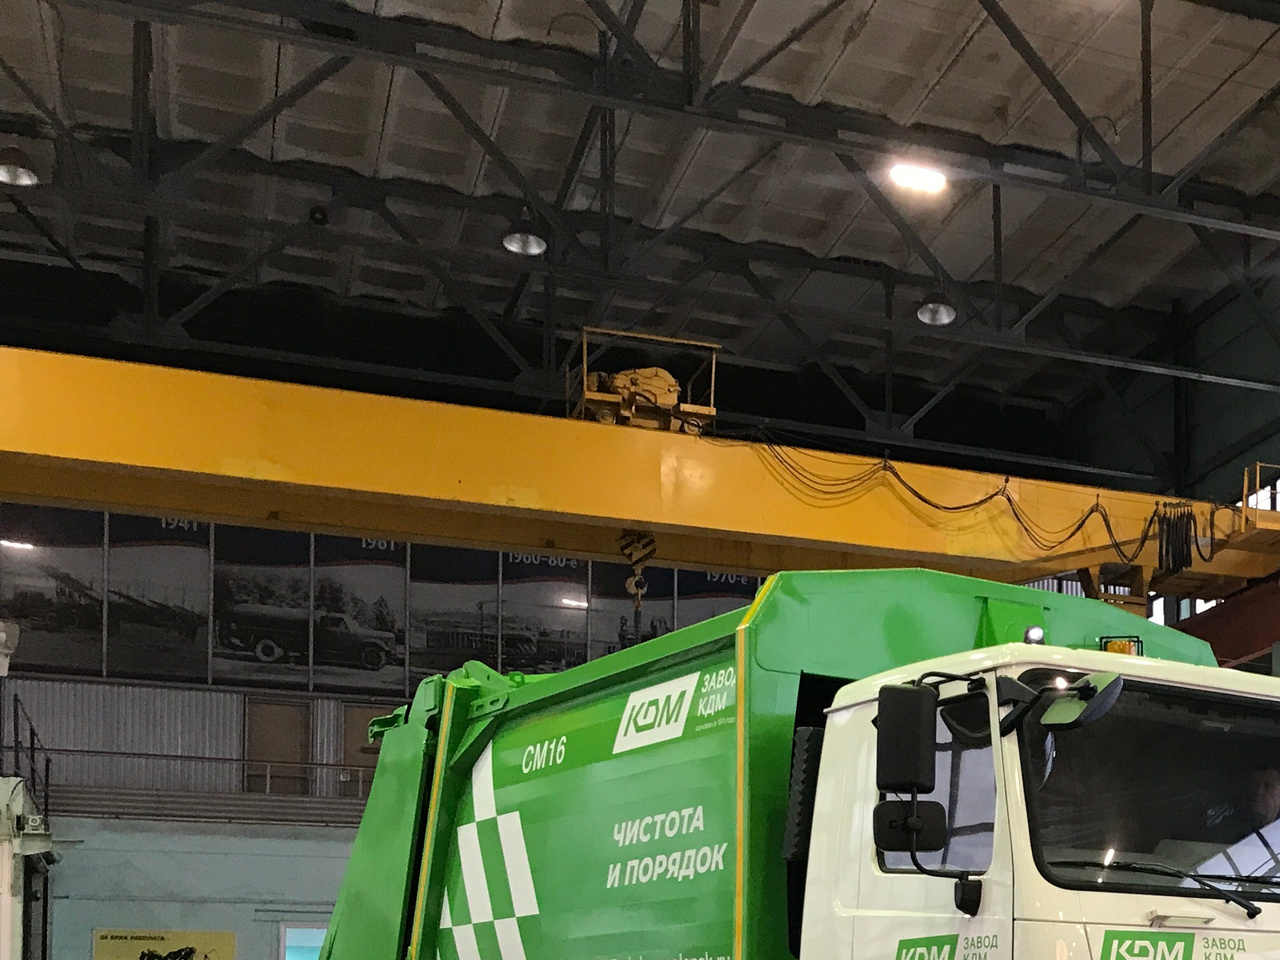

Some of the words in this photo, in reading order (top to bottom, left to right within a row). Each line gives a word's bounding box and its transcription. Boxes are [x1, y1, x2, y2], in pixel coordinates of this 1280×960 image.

[697, 691, 728, 718] КДМ
[613, 805, 705, 848] ЧИСТОТА
[606, 862, 622, 889] И
[624, 842, 729, 886] ПОРЯДОК
[963, 934, 999, 950] ЗАВОД
[1202, 937, 1247, 953] ЗАВОД
